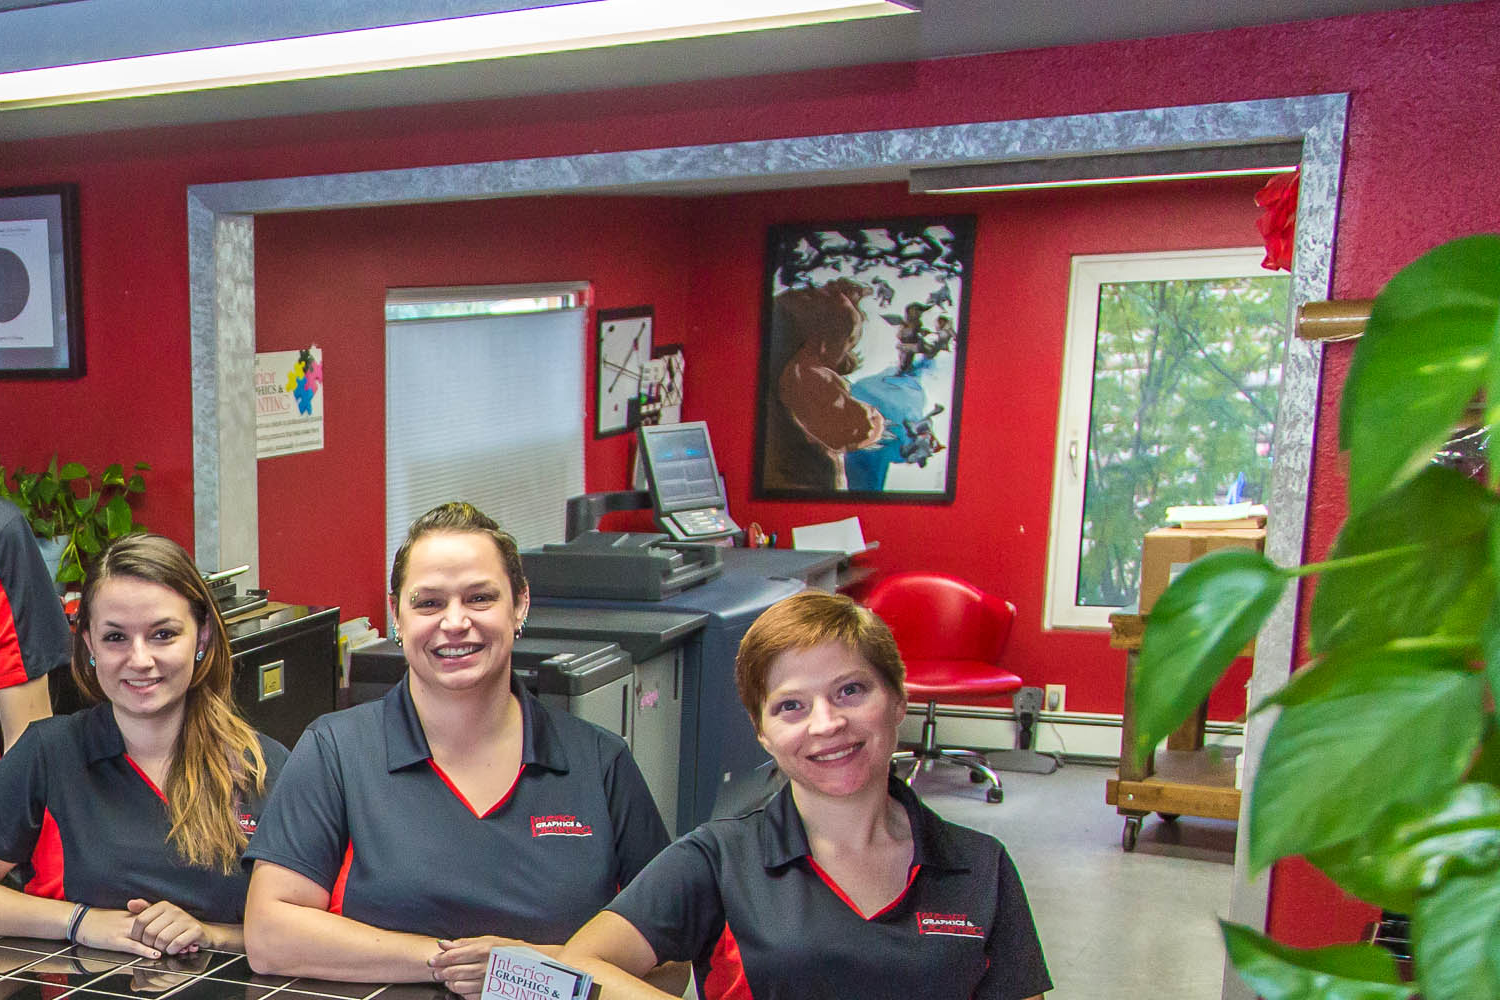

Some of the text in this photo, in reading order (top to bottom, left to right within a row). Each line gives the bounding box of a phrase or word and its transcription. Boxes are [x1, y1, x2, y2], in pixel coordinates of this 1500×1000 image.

[490, 954, 554, 985] Interior
[496, 970, 560, 999] GRAPHICS &
